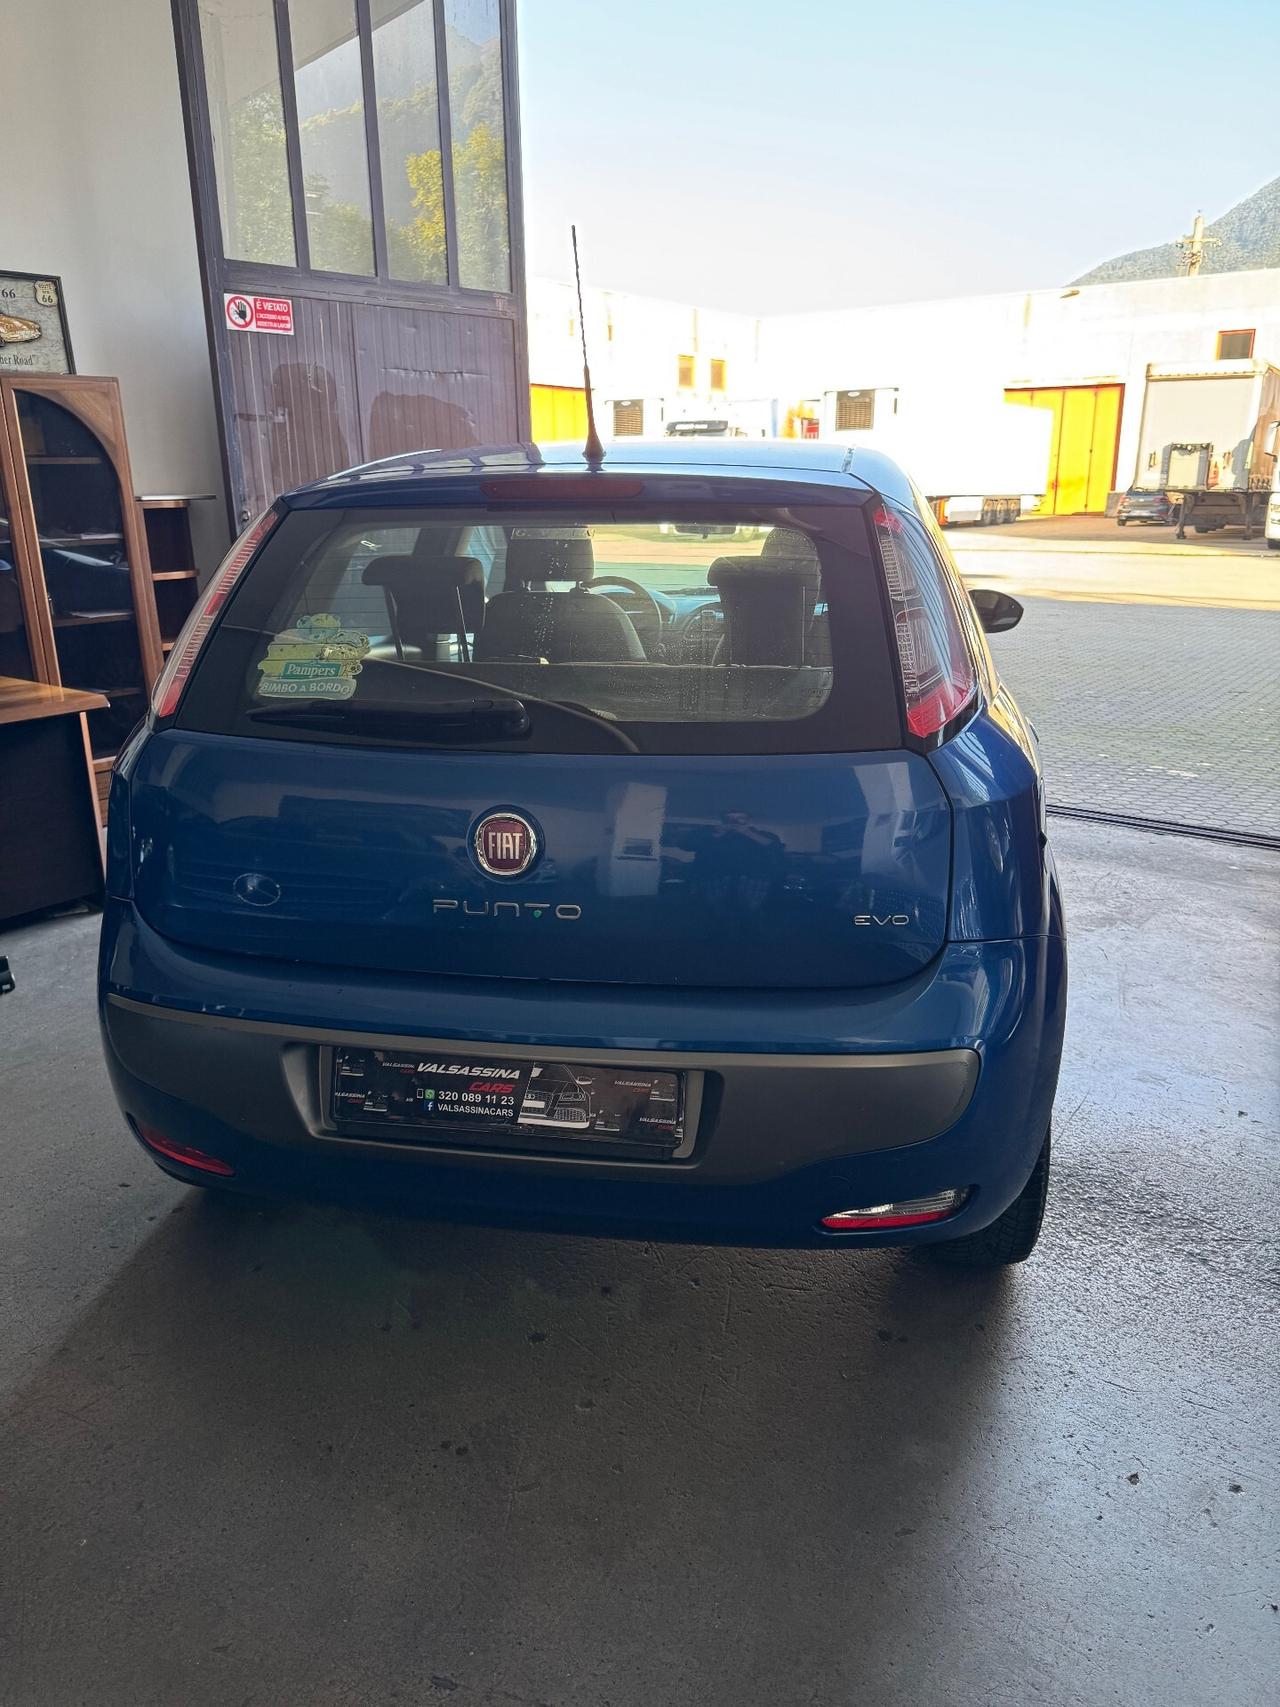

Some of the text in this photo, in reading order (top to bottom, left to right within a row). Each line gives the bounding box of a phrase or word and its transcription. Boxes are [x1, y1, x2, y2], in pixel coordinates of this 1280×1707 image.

[1, 288, 16, 299] 66
[42, 295, 53, 303] 66
[263, 302, 288, 312] VIETATO
[287, 663, 337, 678] Pampers
[261, 682, 297, 693] BIMBO
[309, 682, 350, 695] BORDO
[488, 831, 523, 860] FIAT
[432, 899, 582, 920] PUNTO
[854, 914, 909, 926] EVO
[417, 1062, 521, 1080] VALSASSINA
[468, 1081, 516, 1095] CARS
[438, 1090, 515, 1105] 320 089 11 23
[437, 1103, 514, 1117] VALSASSINACARS
